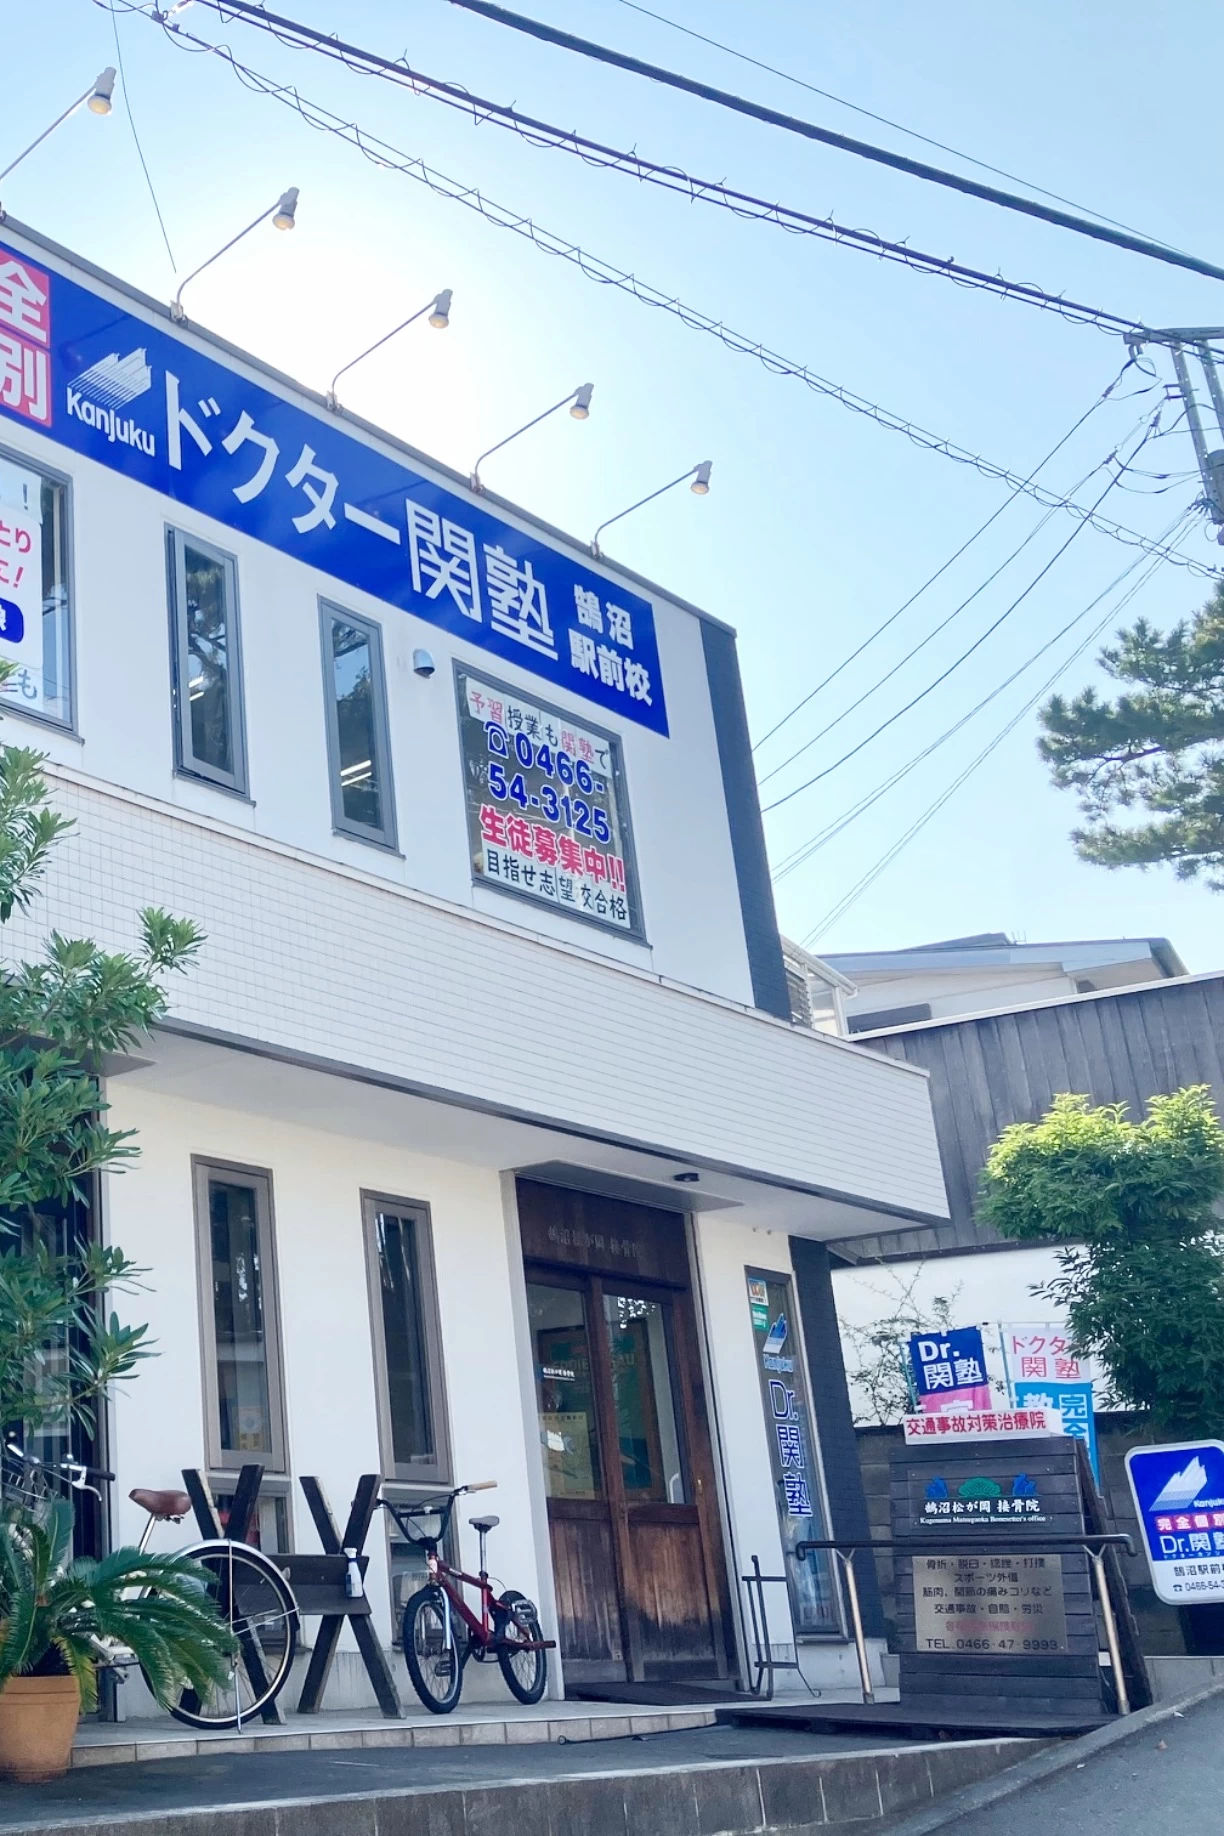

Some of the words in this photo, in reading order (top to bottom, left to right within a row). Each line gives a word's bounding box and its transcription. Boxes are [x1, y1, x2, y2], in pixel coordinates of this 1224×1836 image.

[66, 387, 155, 457] Kanjuku
[165, 369, 558, 661] ドクター関塾
[568, 628, 653, 707] 駅前校
[487, 761, 611, 844] 54-3125
[479, 804, 626, 892] 生徒募集中!!
[918, 1341, 960, 1362] Dr.
[1012, 1335, 1066, 1355] ドクタ
[923, 1357, 983, 1390] 関塾
[1022, 1357, 1082, 1379] 関塾
[906, 1411, 1046, 1436] 交通事故対策治療院
[997, 1499, 1040, 1513] 接骨院
[1173, 1563, 1224, 1577] 鵠沼駅前
